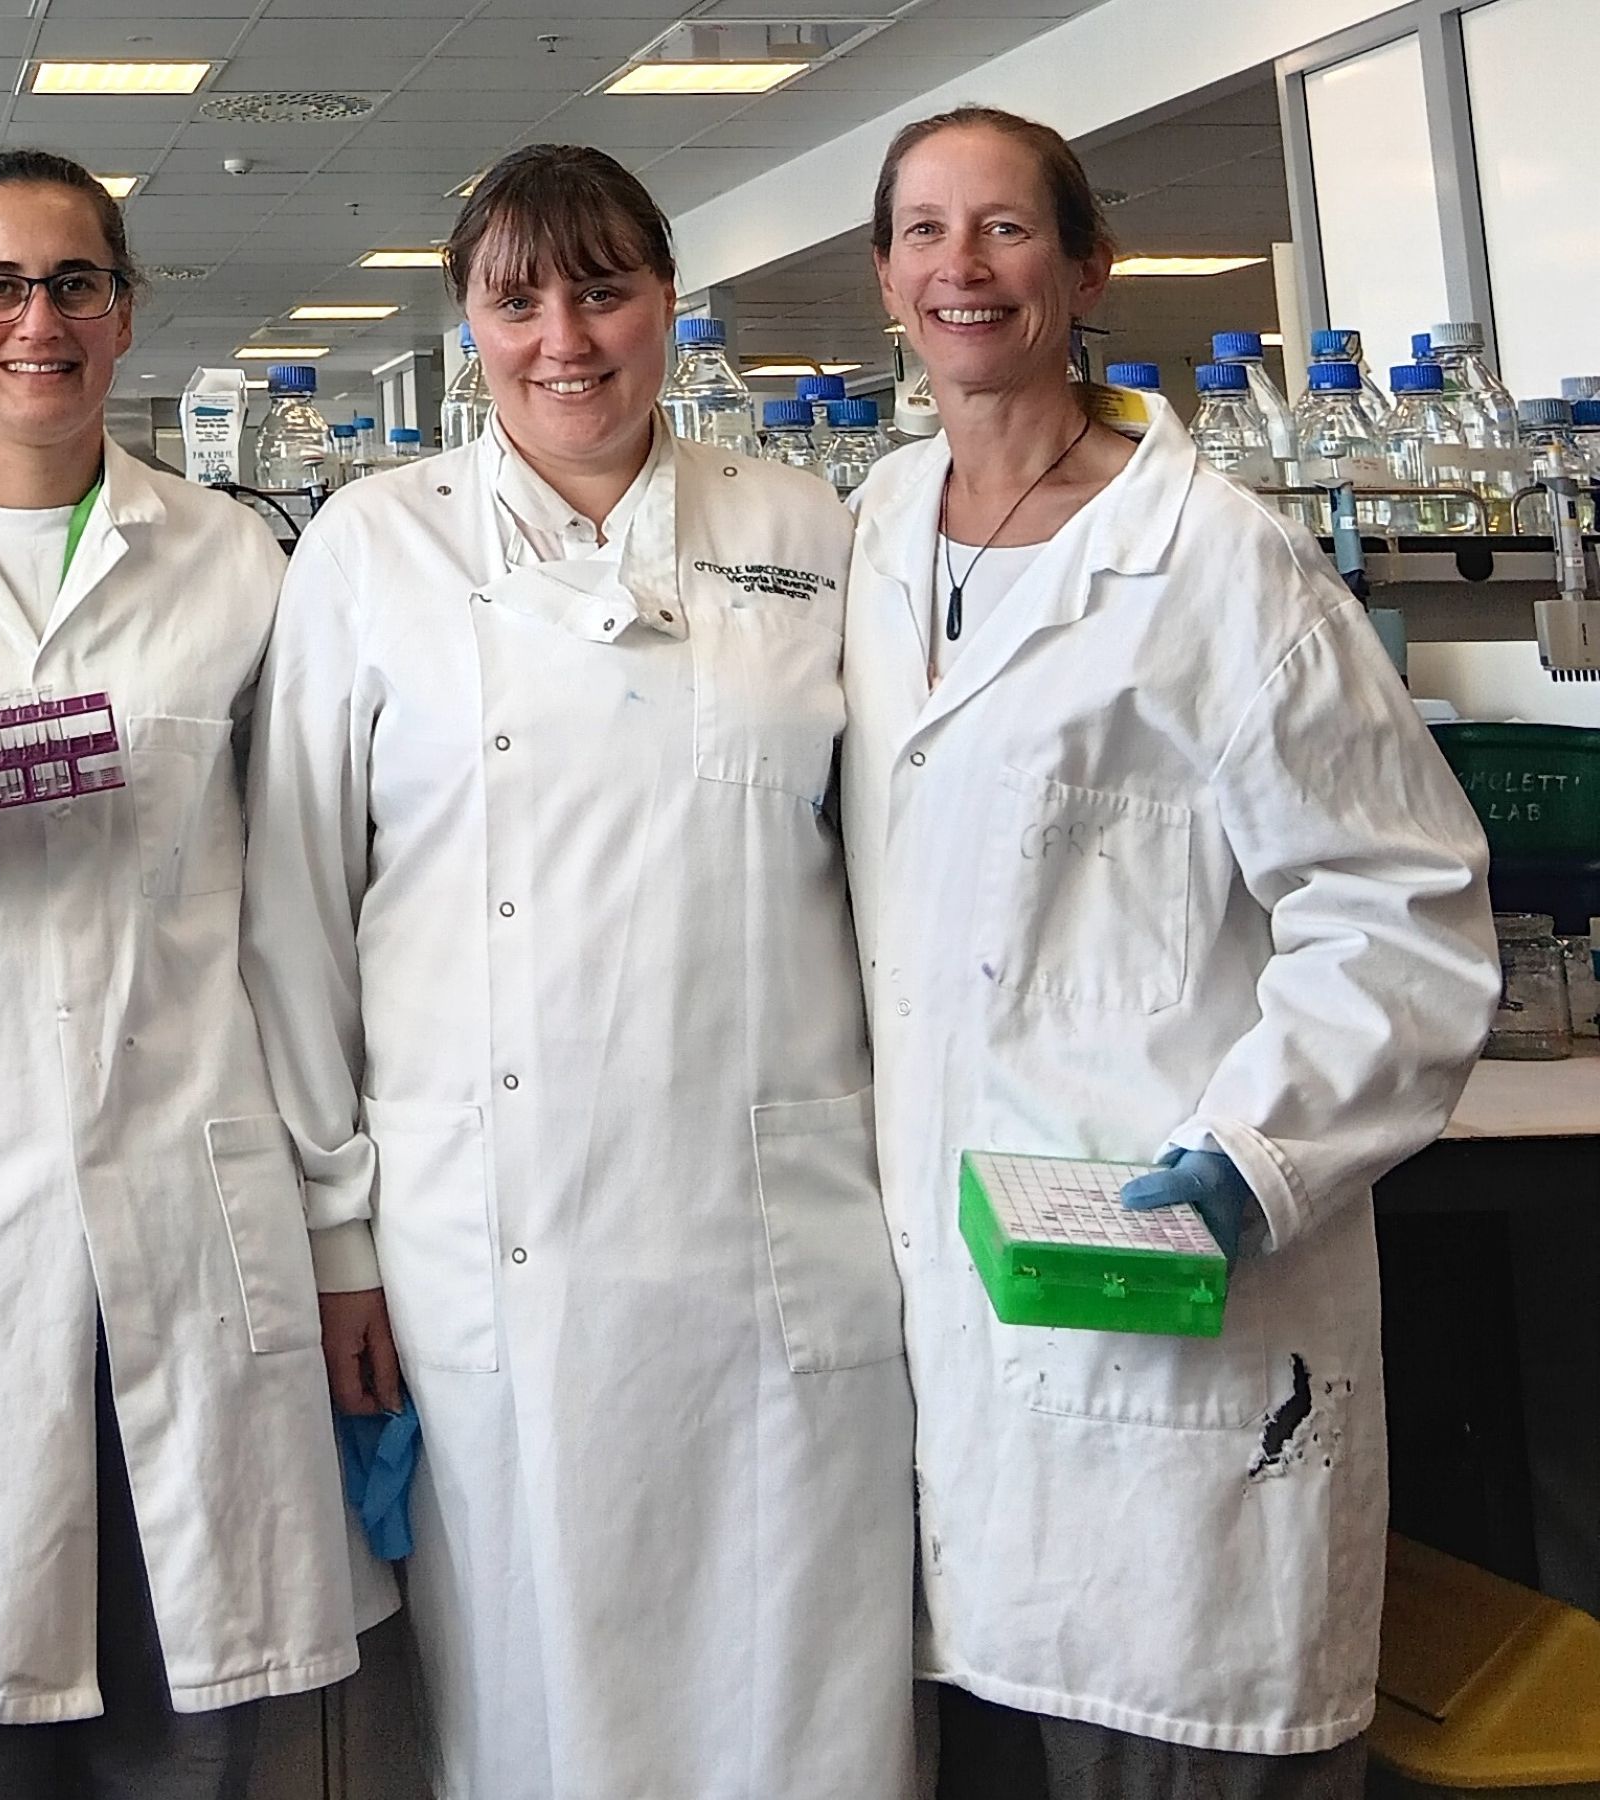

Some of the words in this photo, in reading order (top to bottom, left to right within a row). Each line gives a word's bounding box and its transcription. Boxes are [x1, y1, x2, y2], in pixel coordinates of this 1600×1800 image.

[726, 574, 769, 584] Victoria
[771, 575, 817, 594] University
[743, 582, 755, 592] of
[757, 580, 811, 601] Wellington
[1489, 803, 1541, 821] LAB
